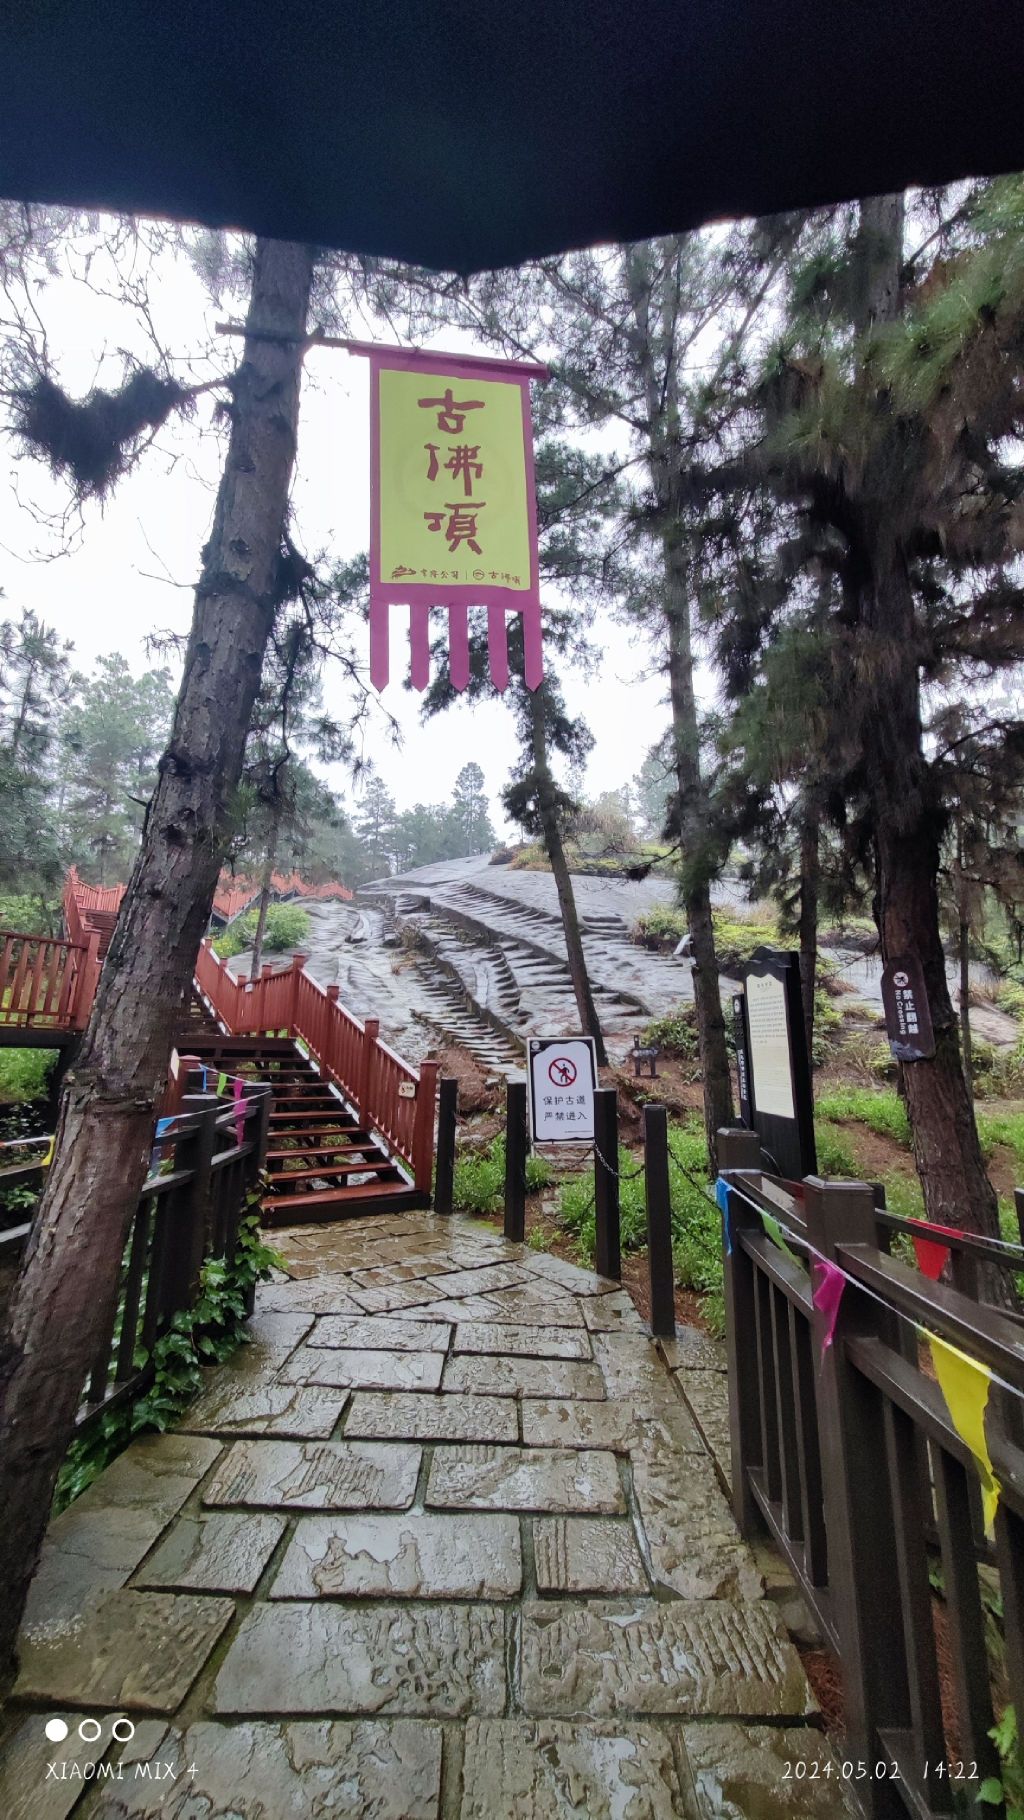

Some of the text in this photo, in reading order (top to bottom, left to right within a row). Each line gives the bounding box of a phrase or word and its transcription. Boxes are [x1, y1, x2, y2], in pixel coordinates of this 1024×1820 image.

[895, 989, 907, 1035] No Crossing
[542, 1095, 586, 1106] 保护古道
[544, 1111, 588, 1122] 严禁进入
